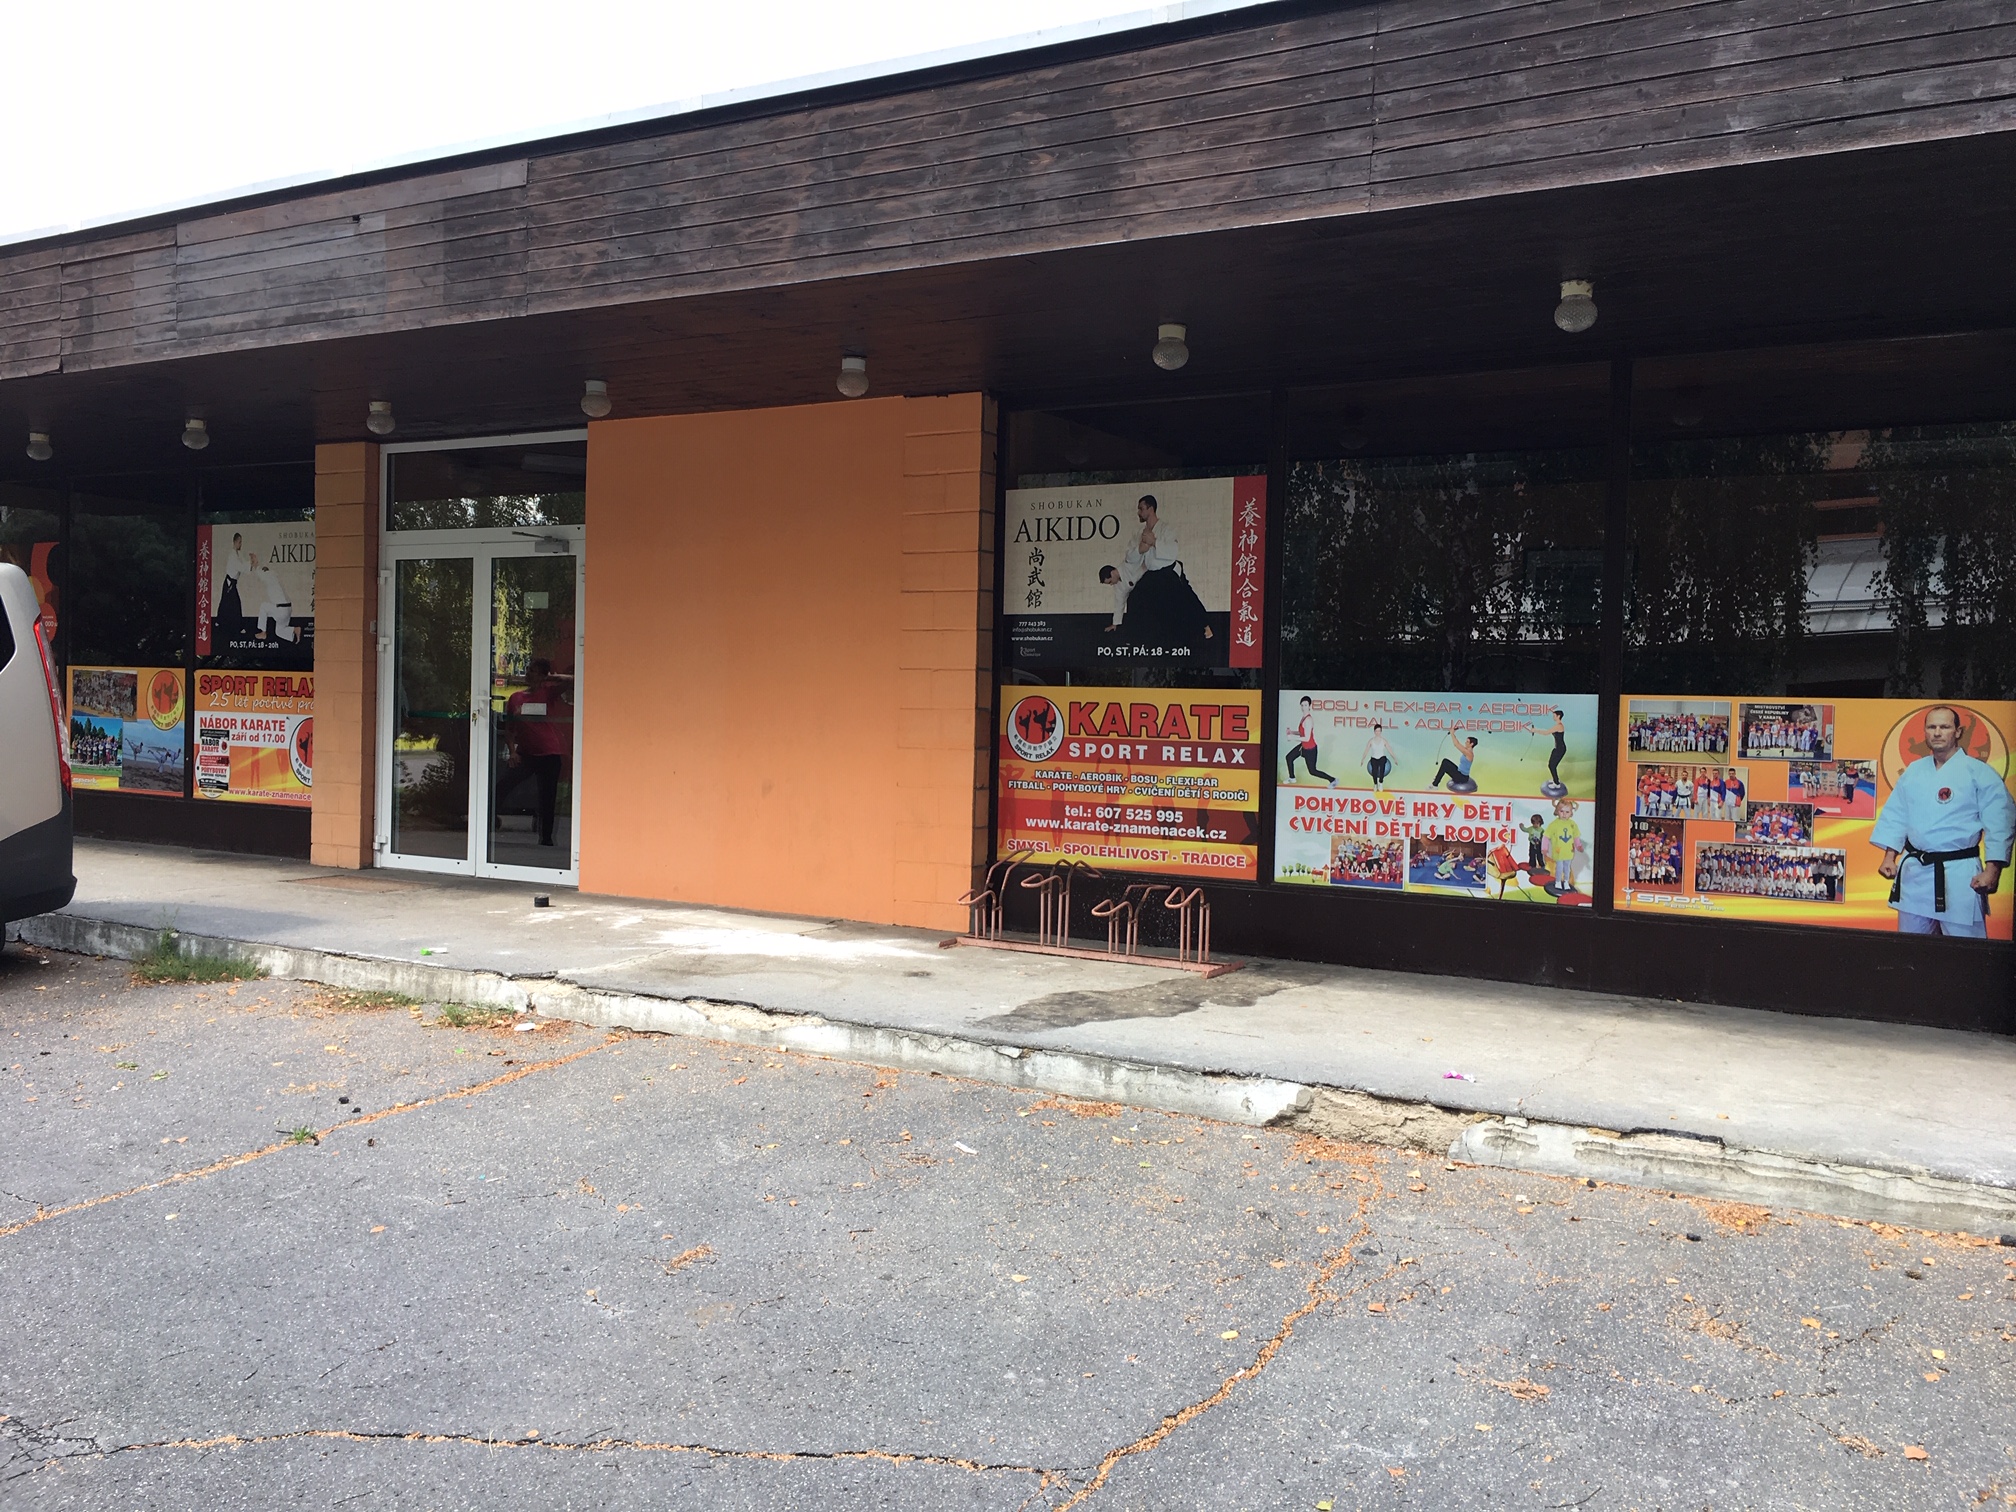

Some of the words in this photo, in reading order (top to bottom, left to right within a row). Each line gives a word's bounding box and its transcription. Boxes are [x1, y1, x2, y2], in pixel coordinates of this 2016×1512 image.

[1030, 499, 1103, 511] SHOBUKAN
[1013, 514, 1120, 543] AIKIDO
[1024, 546, 1046, 609] 尚武館
[1097, 646, 1114, 657] PO,
[1116, 646, 1131, 657] ST,
[1133, 644, 1149, 656] PÁ:
[1151, 646, 1163, 656] 18
[1171, 646, 1191, 656] 20h
[199, 674, 258, 696] SPORT
[210, 691, 231, 707] 25
[234, 695, 249, 708] let
[1311, 699, 1359, 712] BOSU
[1374, 700, 1462, 714] FLEXI-BAR
[1479, 702, 1559, 716] AEROBIK
[199, 714, 238, 730] NÁBOR
[241, 718, 286, 732] KARATE
[1068, 701, 1250, 741] KARATE
[1333, 716, 1399, 729] FITBALL
[1415, 718, 1533, 733] AQUAEROBIK
[231, 731, 247, 742] září
[249, 733, 260, 742] od
[262, 734, 286, 744] 17.00
[1014, 744, 1033, 759] SPORT
[1035, 746, 1055, 760] RELAX
[1069, 742, 1148, 760] SPORT
[1162, 746, 1246, 764] RELAX
[1035, 770, 1073, 780] KARATE
[1079, 773, 1122, 782] AEROBIK
[1130, 775, 1158, 784] BOSU
[1166, 776, 1218, 787] FLEXI-BAR
[1008, 780, 1045, 790] FITBALL
[1052, 783, 1104, 793] POHYBOVÉ
[1106, 785, 1127, 795] HRY
[1134, 786, 1175, 797] CVIČENÍ
[1177, 788, 1201, 798] DĚTÍ
[1203, 791, 1210, 799] S
[1212, 790, 1248, 801] RODIČI
[1065, 805, 1092, 817] tel.:
[1095, 806, 1122, 819] 607
[1126, 808, 1152, 821] 525
[1156, 810, 1184, 823] 995
[1294, 795, 1406, 816] POHYBOVÉ
[1413, 802, 1455, 818] HRY
[1464, 800, 1513, 822] DĚTÍ
[1025, 817, 1227, 840] www.karate-znamenacek.cz
[1289, 814, 1368, 835] CVIČENÍ
[1375, 818, 1421, 838] DĚTÍ
[1428, 824, 1437, 840] S
[1444, 824, 1516, 844] RODIČI
[1007, 839, 1051, 853] SMYSL
[1063, 843, 1169, 862] SPOLEHLIVOST
[1181, 852, 1246, 867] TRADICE
